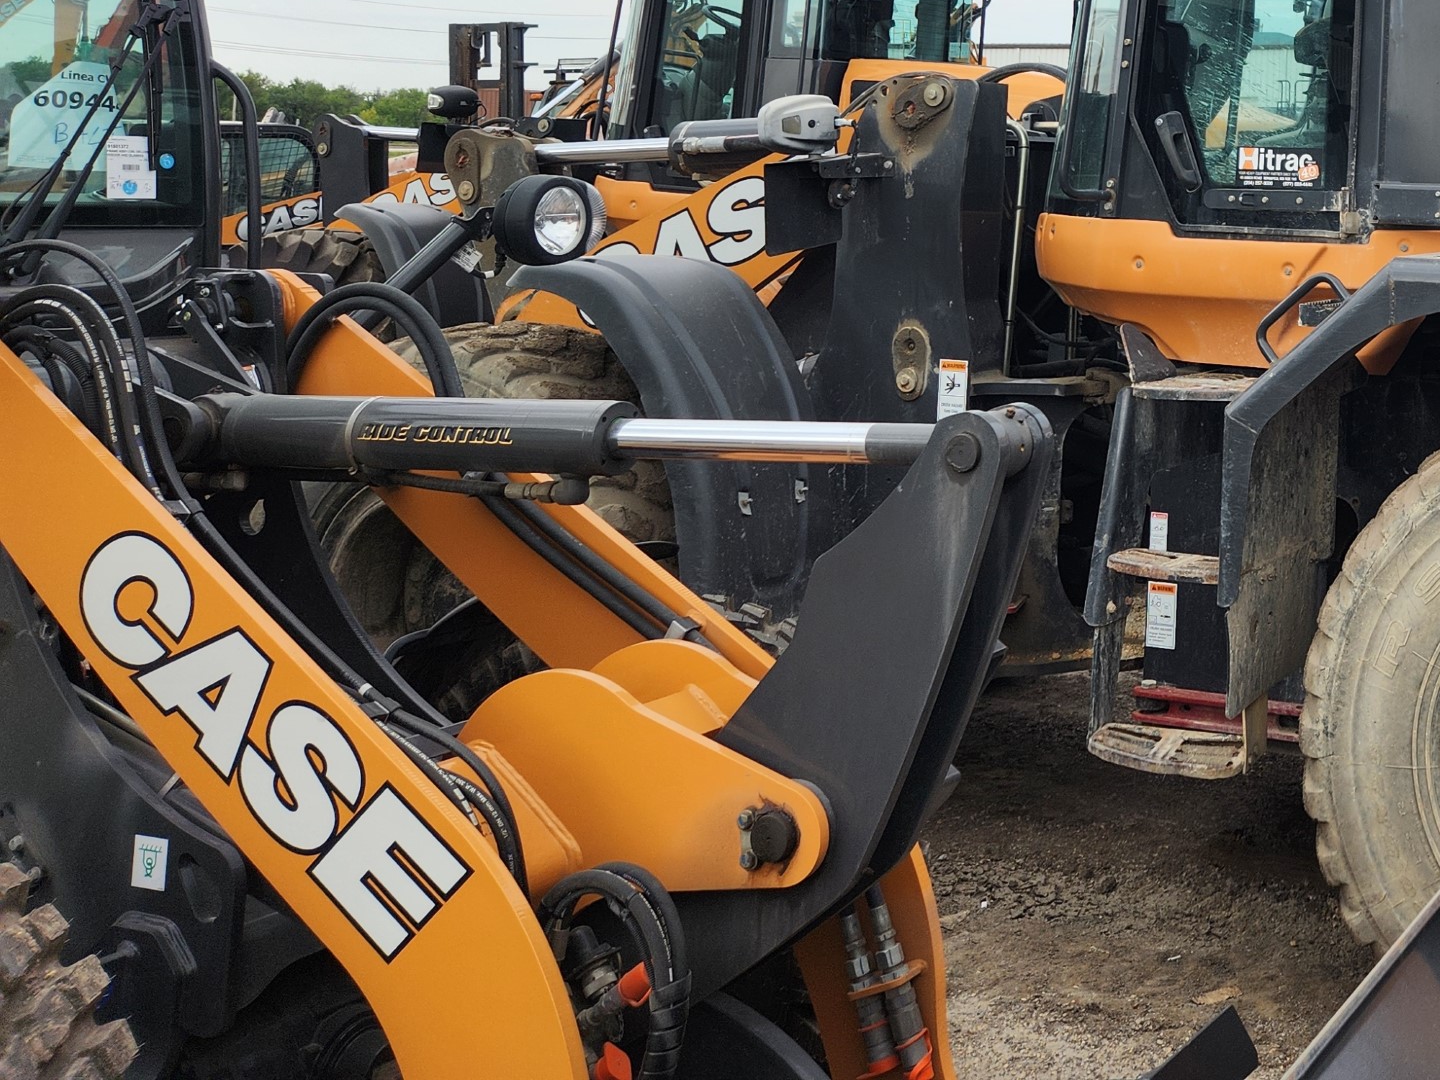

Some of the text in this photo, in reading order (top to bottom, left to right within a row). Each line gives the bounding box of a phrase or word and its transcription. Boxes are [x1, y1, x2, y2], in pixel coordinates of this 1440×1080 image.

[61, 71, 94, 82] Linea
[33, 90, 121, 113] 60944
[1238, 147, 1314, 172] Hitrac
[237, 196, 323, 242] CAS
[594, 176, 766, 265] AS
[357, 423, 513, 445] RIDE CONTROL
[79, 530, 475, 964] CASE
